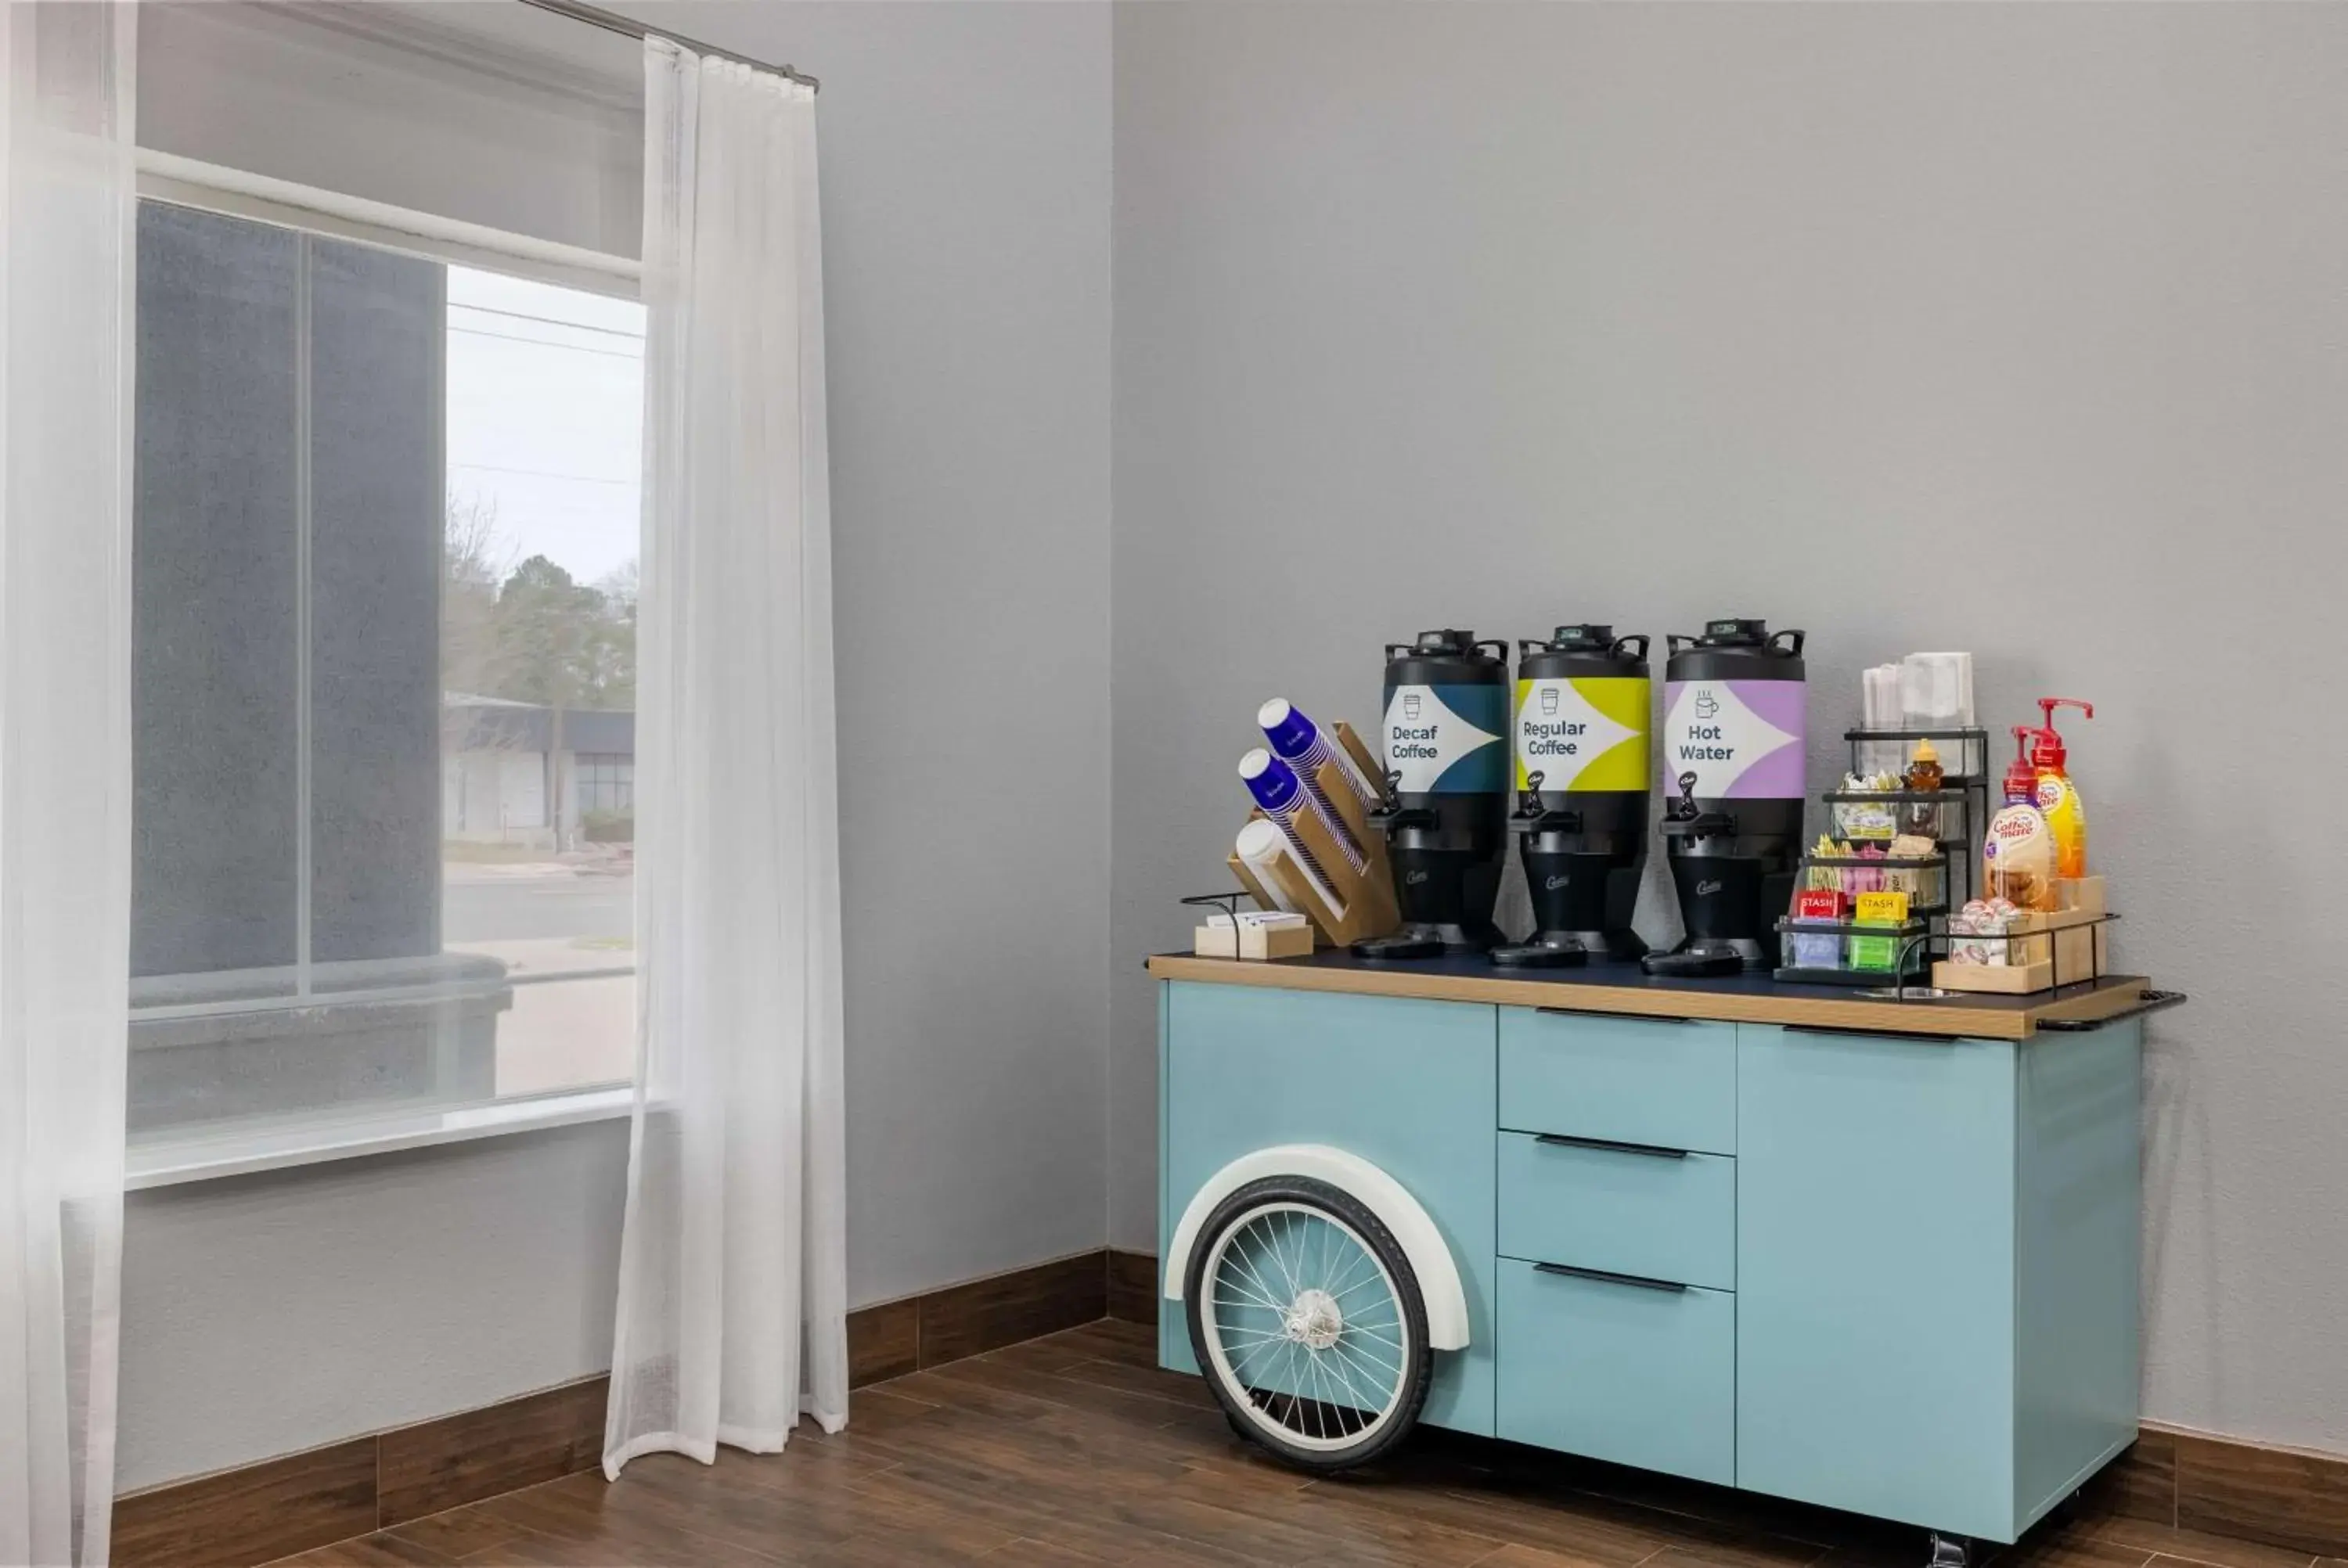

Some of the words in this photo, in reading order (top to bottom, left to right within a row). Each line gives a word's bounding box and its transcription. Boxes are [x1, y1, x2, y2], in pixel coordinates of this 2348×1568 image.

[1392, 725, 1439, 739] Decaf
[1524, 720, 1586, 739] Regular
[1688, 725, 1721, 739] Hot
[1392, 744, 1439, 758] Coffee
[1529, 739, 1578, 755] Coffee
[1679, 745, 1735, 761] Water
[1802, 897, 1833, 908] STASH
[1860, 898, 1894, 908] STASH
